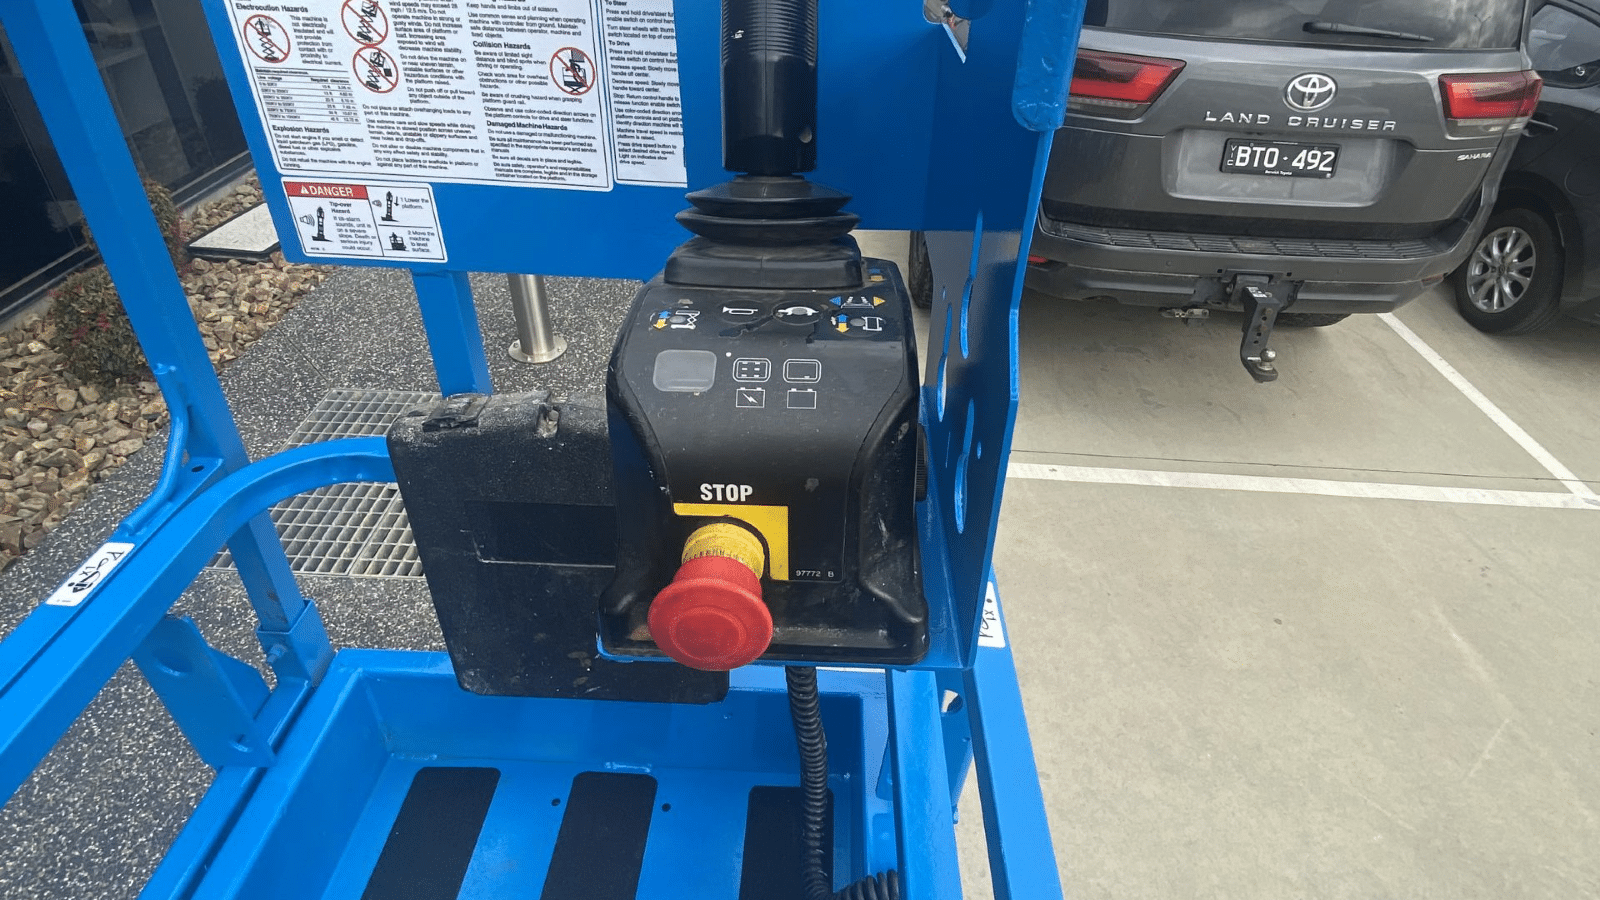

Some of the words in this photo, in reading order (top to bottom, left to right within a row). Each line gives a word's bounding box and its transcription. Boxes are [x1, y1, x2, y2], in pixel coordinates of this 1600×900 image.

[236, 3, 280, 11] Electrocution
[473, 40, 502, 48] Collision
[504, 41, 531, 50] Hazards
[486, 120, 516, 129] Damaged
[516, 121, 542, 129] Machine
[542, 122, 568, 130] Hazards
[1204, 111, 1271, 124] LAND
[1287, 116, 1396, 131] CRUISER
[272, 125, 303, 133] Explosion
[1457, 152, 1491, 161] SAHARA
[309, 185, 353, 197] DANGER
[700, 483, 753, 502] STOP
